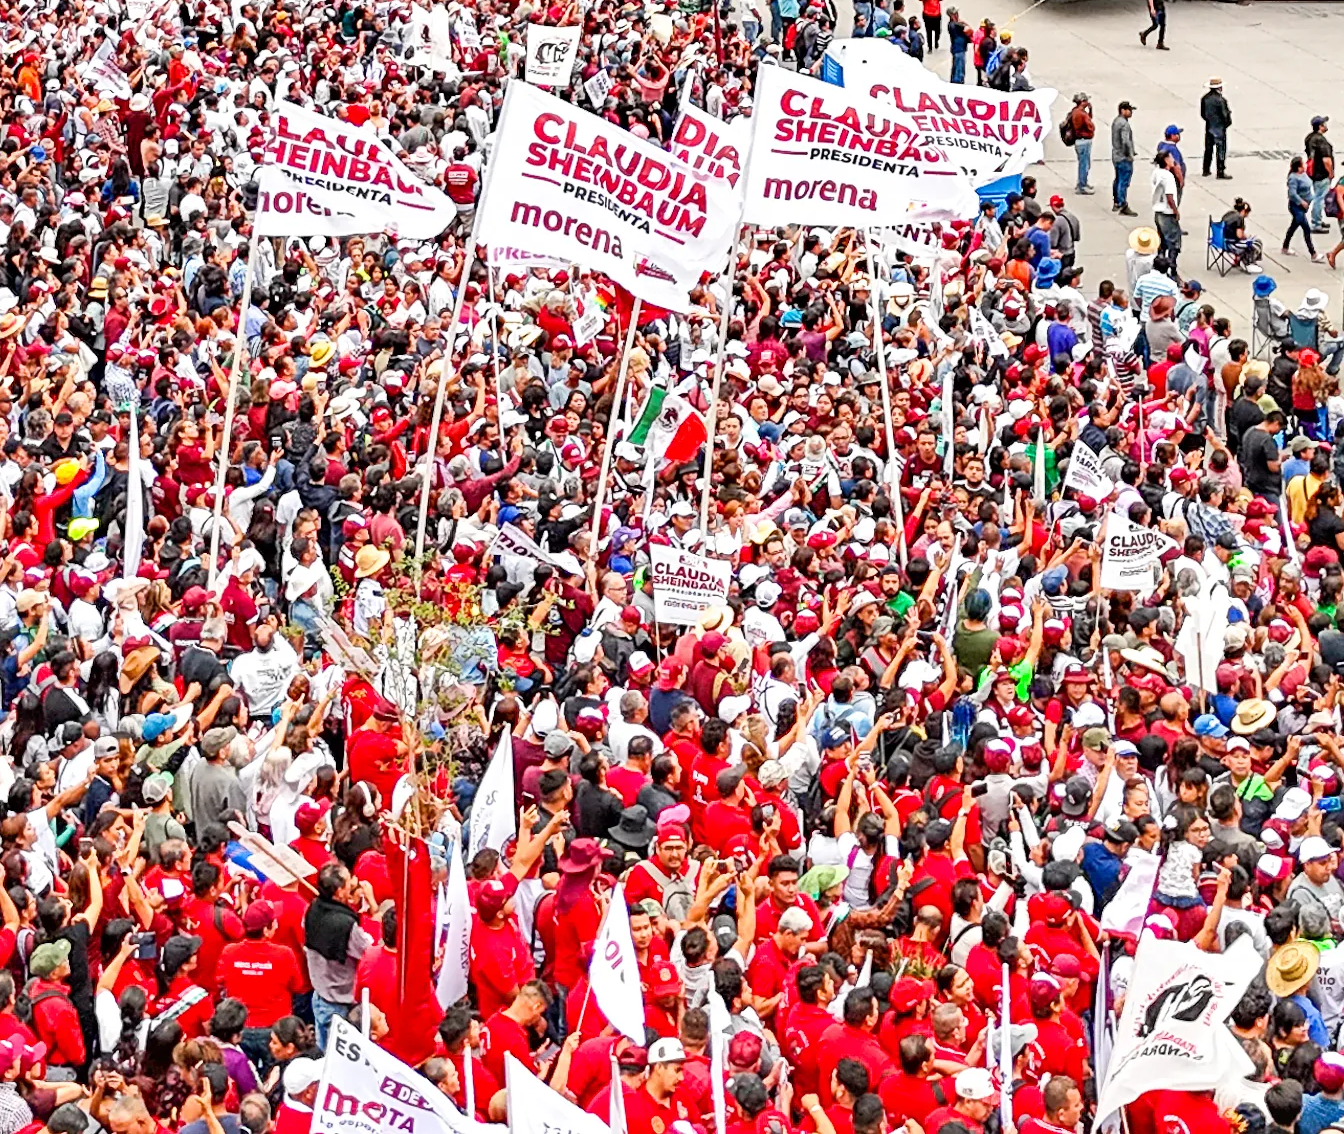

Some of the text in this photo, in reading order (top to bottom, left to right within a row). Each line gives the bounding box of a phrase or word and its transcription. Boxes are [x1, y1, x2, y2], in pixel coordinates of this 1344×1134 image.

[533, 112, 708, 214] CLAUDIA
[674, 114, 741, 171] DIA
[809, 147, 920, 179] PRESIDENTA
[525, 141, 708, 239] SHEINBAUM
[562, 181, 651, 235] PRESIDENTA
[763, 176, 877, 212] morena
[510, 200, 623, 260] morena
[655, 562, 725, 589] CLAUDIA
[382, 1080, 396, 1095] 2
